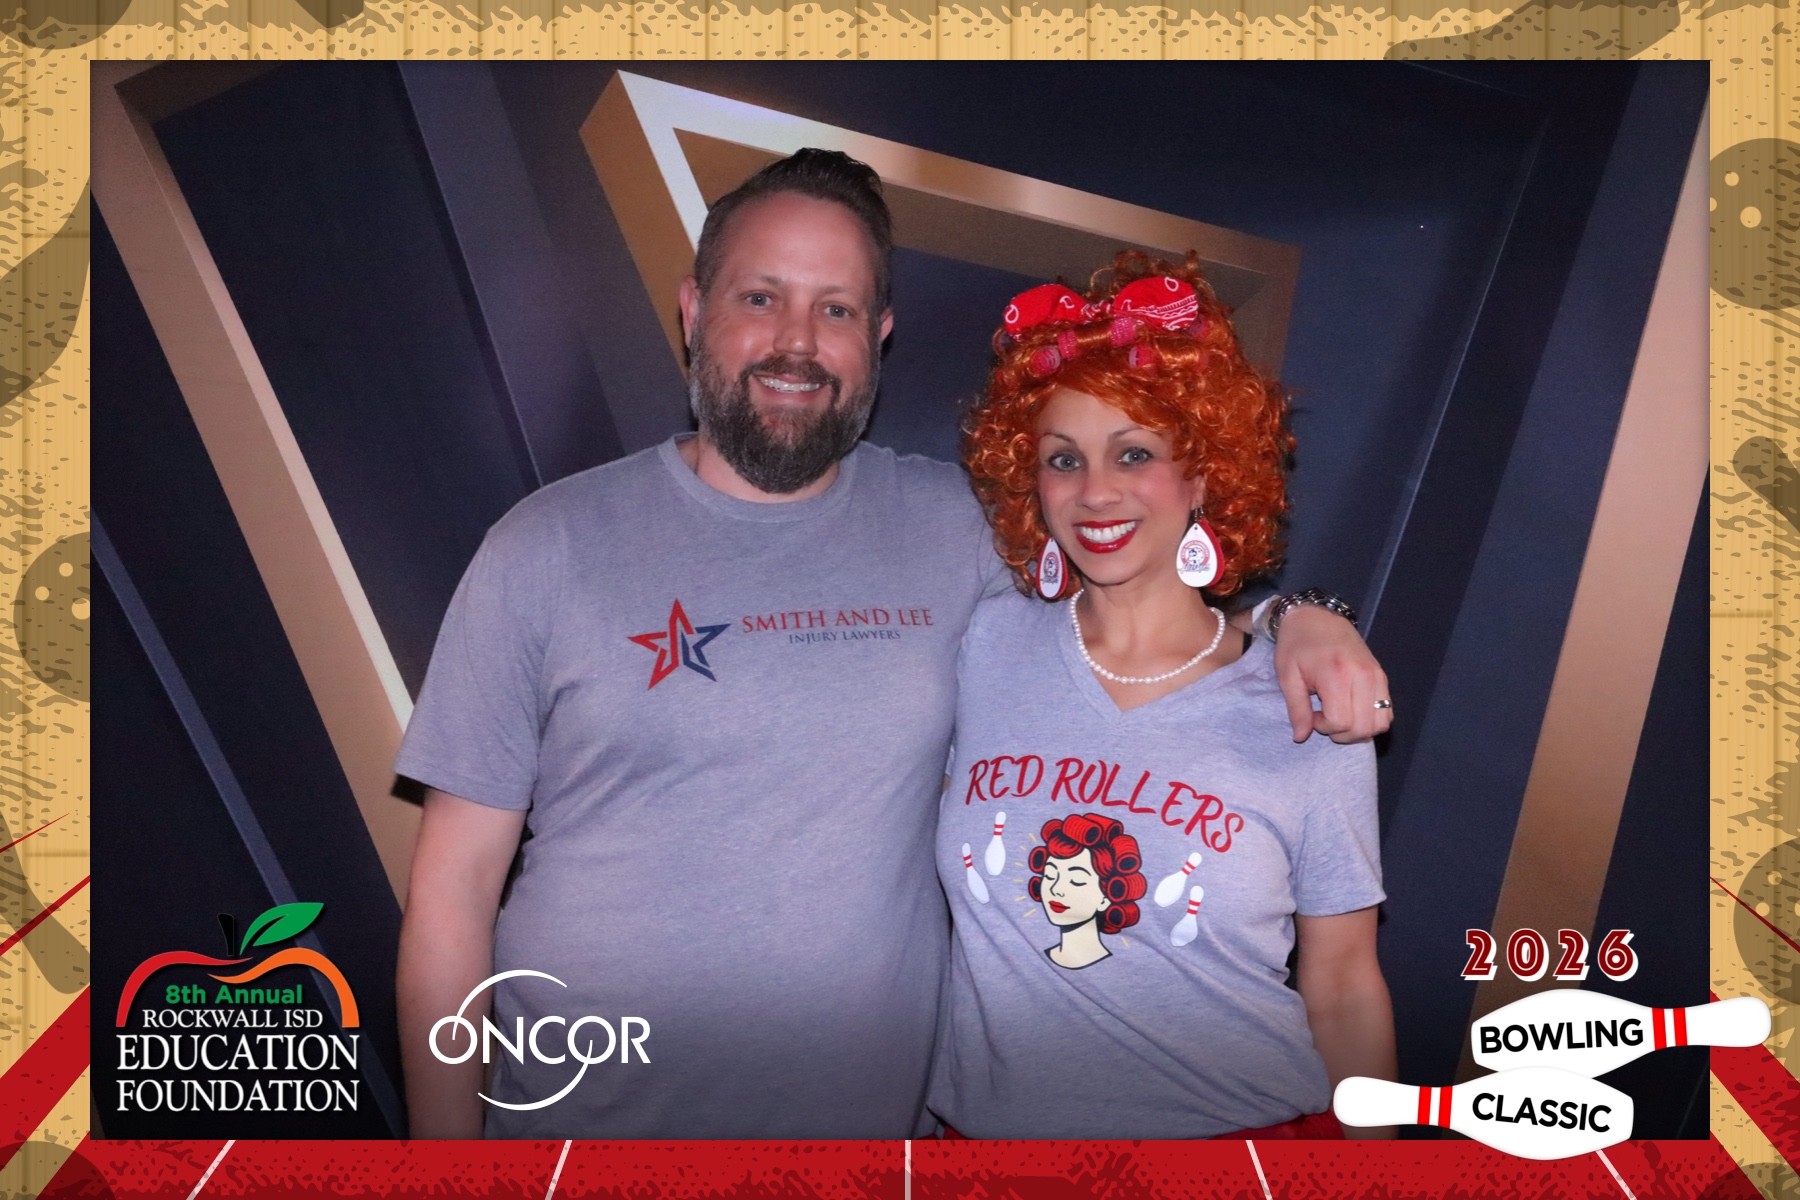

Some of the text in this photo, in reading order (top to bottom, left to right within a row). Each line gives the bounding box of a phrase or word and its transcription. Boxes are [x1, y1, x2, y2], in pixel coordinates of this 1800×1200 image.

[742, 608, 934, 633] SMITH AND LEE
[788, 629, 901, 644] INJURY LAWYERS
[965, 754, 1244, 853] RED ROLLERS
